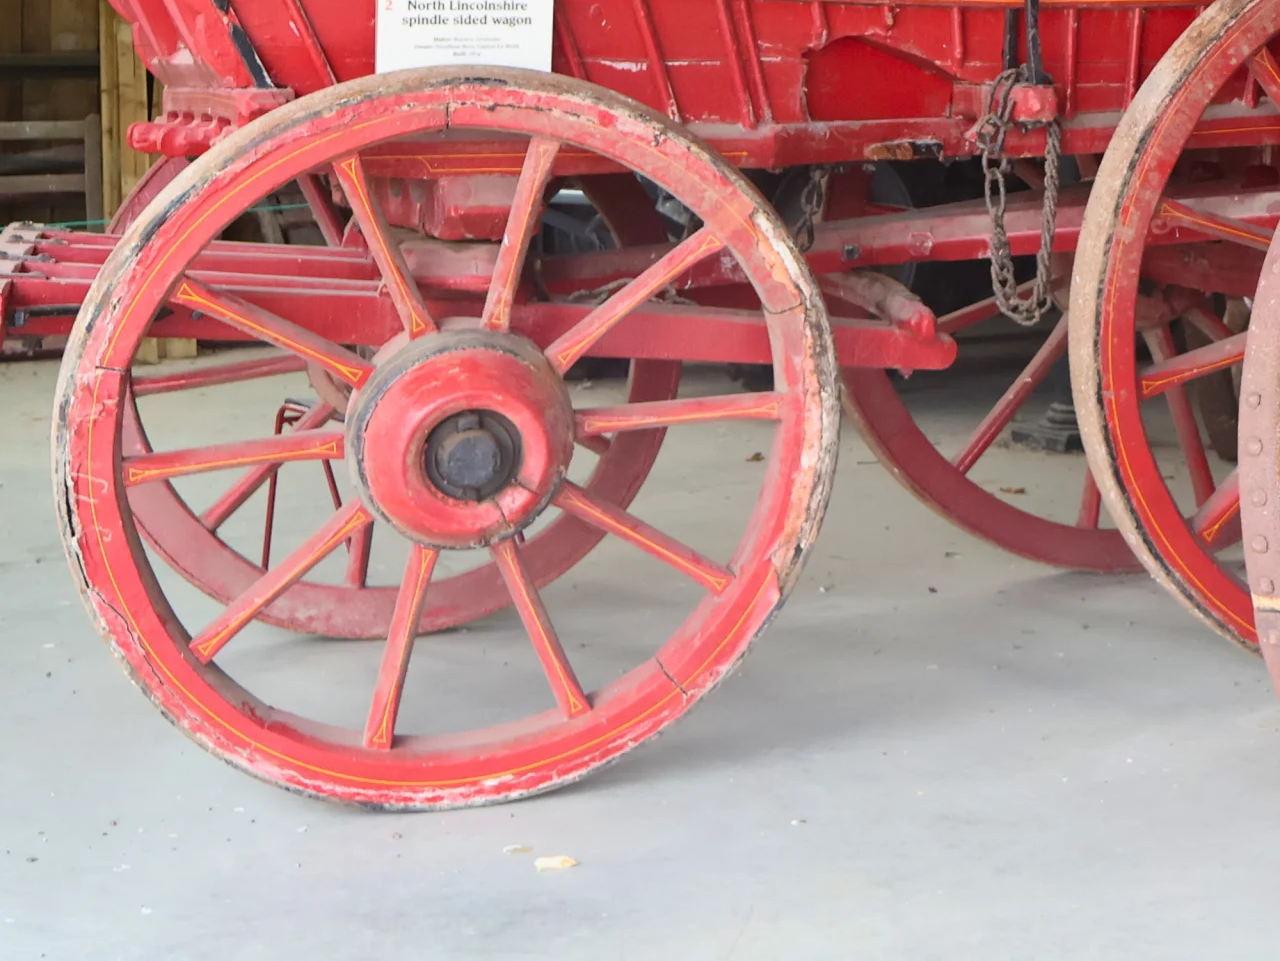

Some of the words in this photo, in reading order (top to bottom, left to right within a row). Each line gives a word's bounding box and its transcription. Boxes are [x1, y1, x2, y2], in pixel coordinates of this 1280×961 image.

[385, 0, 394, 11] 2
[407, 0, 446, 11] North
[449, 0, 528, 11] Lincolnshire
[402, 14, 449, 27] spindle
[453, 14, 488, 25] sided
[492, 17, 532, 28] wagon
